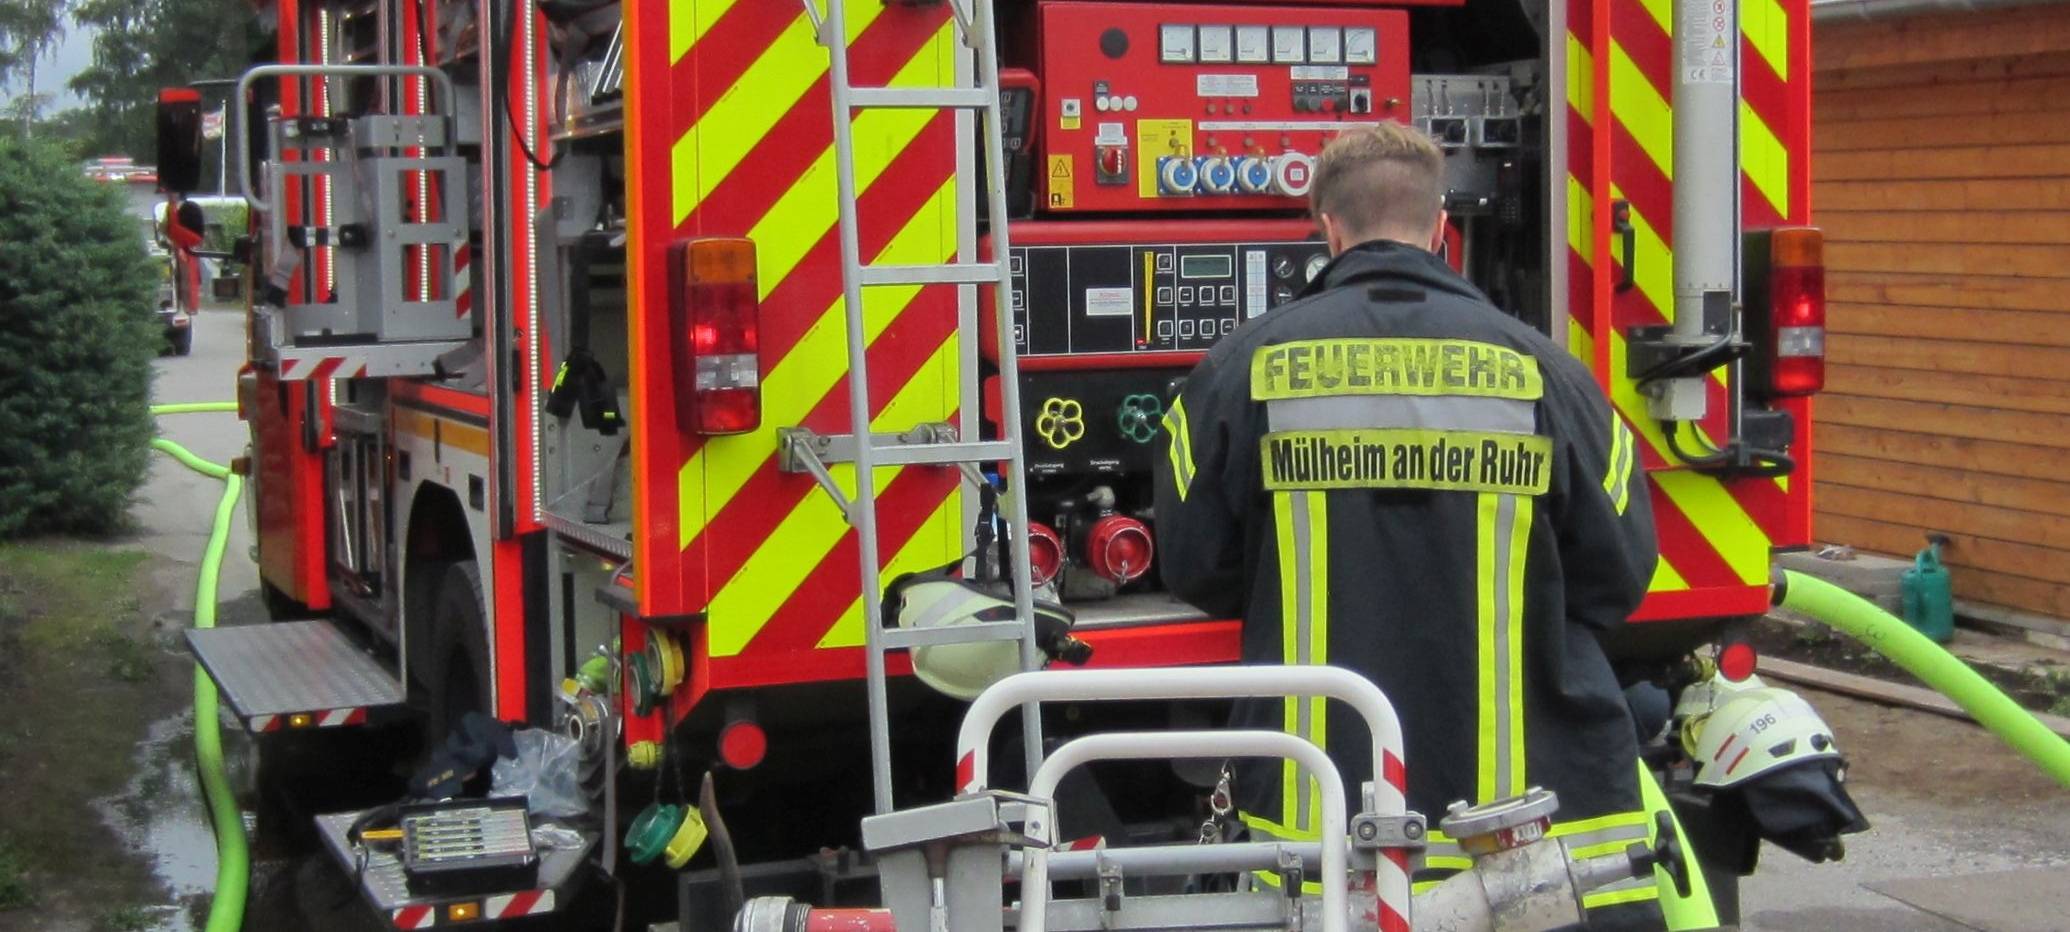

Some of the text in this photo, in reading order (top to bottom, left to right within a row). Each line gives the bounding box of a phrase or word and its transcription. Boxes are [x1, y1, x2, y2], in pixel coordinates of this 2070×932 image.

[1264, 343, 1527, 393] FEUERWEHR
[1270, 436, 1544, 488] Mülheim an der Ruhr
[1749, 713, 1776, 735] 196
